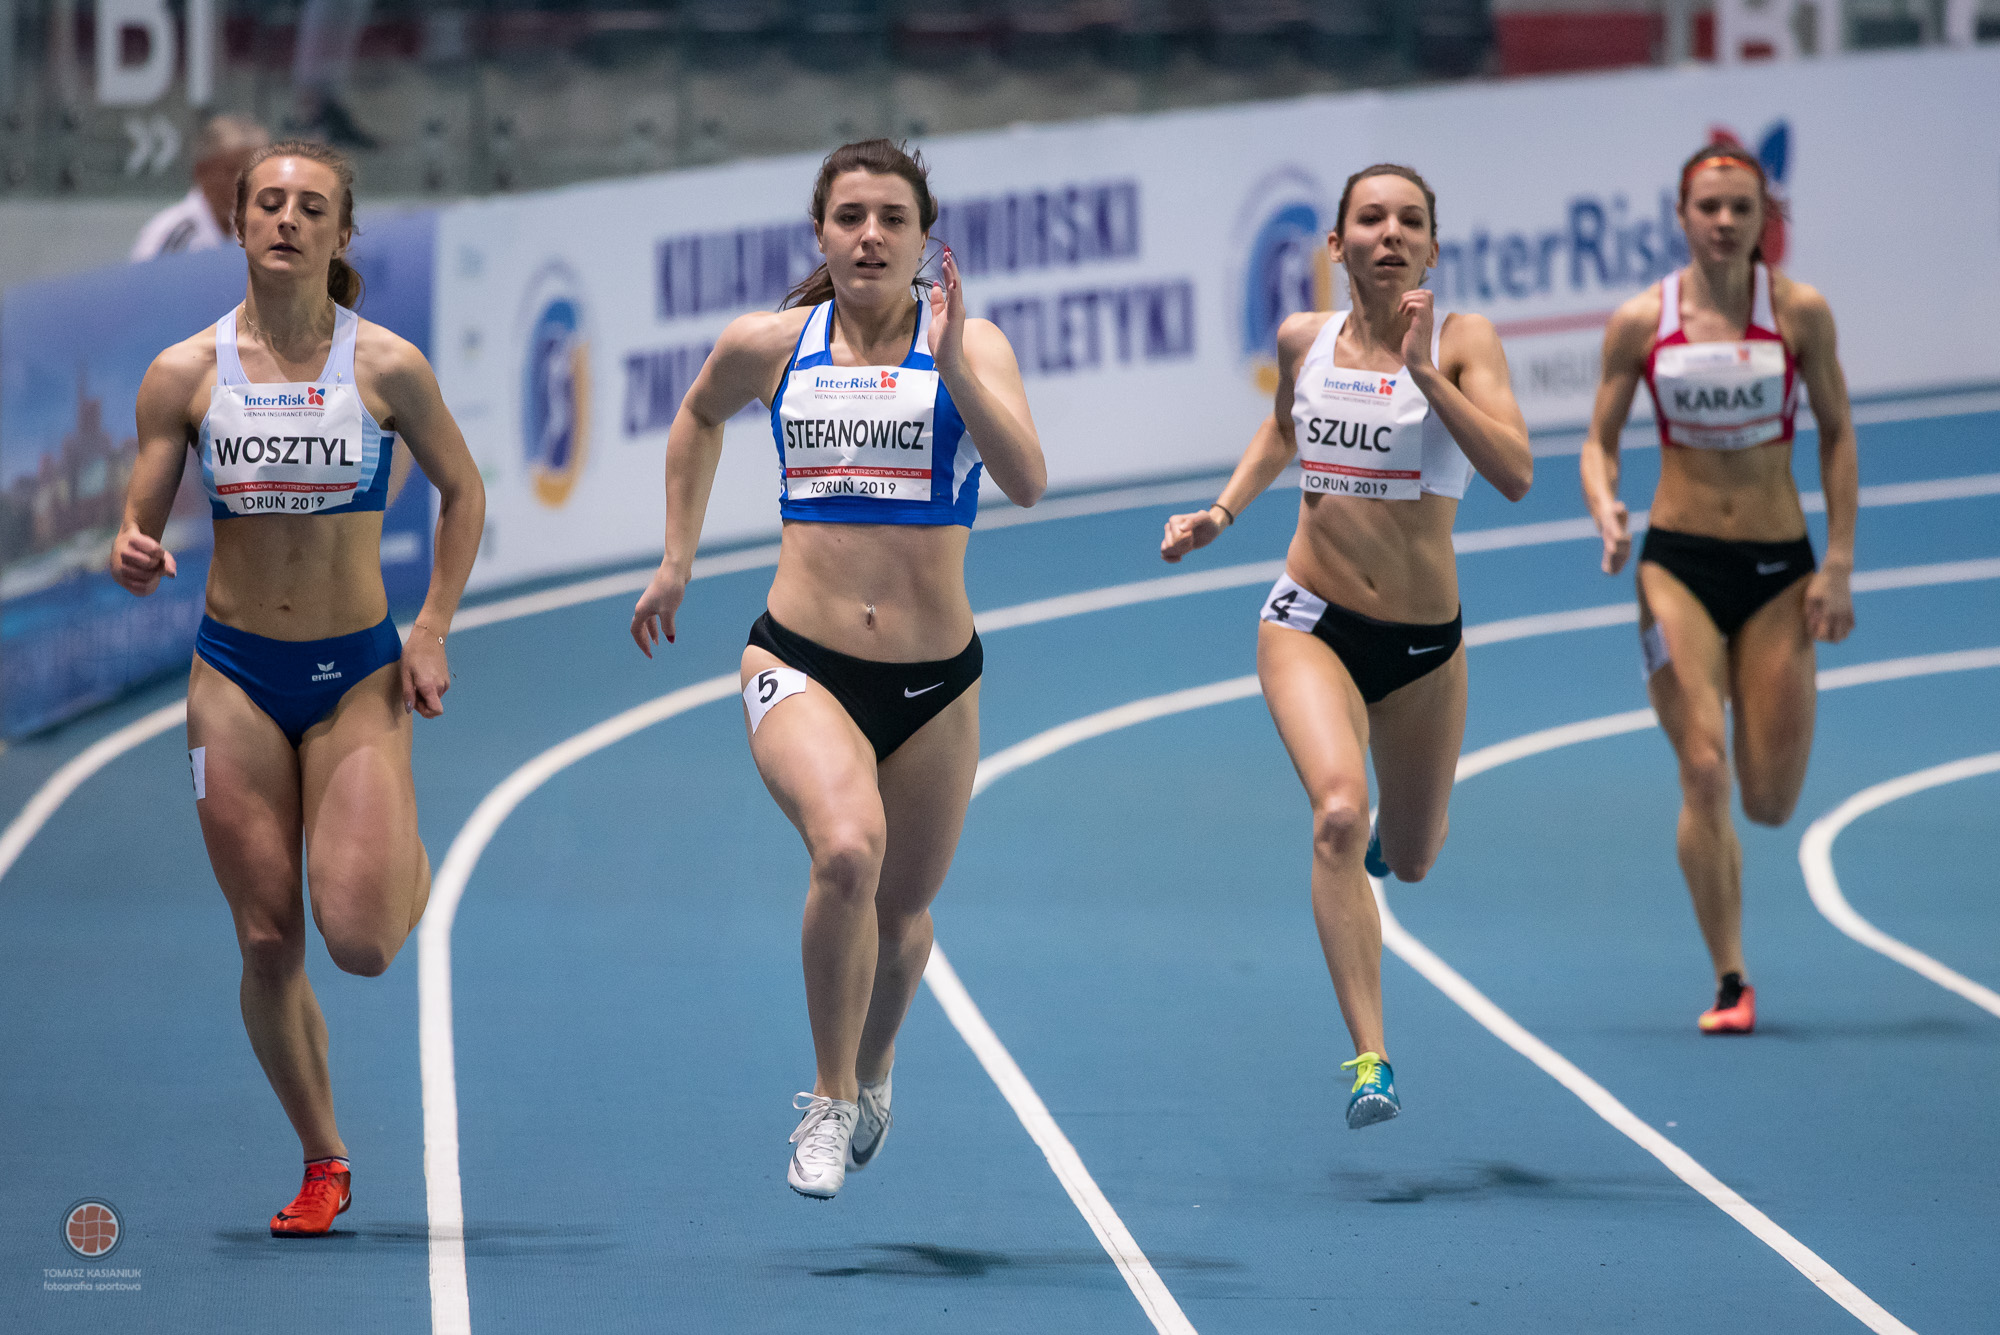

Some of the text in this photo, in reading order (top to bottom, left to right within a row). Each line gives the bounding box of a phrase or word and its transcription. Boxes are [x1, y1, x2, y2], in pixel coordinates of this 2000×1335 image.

[815, 376, 878, 389] InterRisk
[1323, 378, 1377, 394] InterRisk
[244, 393, 305, 406] InterRisk
[786, 419, 925, 450] STEFANOWICZ
[1307, 417, 1392, 453] SZULC
[215, 436, 354, 467] WOSZTYL
[842, 468, 896, 476] MISTRZOSTWA
[244, 483, 273, 491] HALOWE
[274, 484, 325, 492] MISTRZOSTWA
[810, 477, 897, 495] TORUŃ 2019
[1354, 481, 1388, 496] 2019
[240, 492, 325, 510] TORUŃ 2019
[1270, 590, 1298, 621] 4
[312, 672, 342, 682] erima
[758, 669, 779, 704] 5
